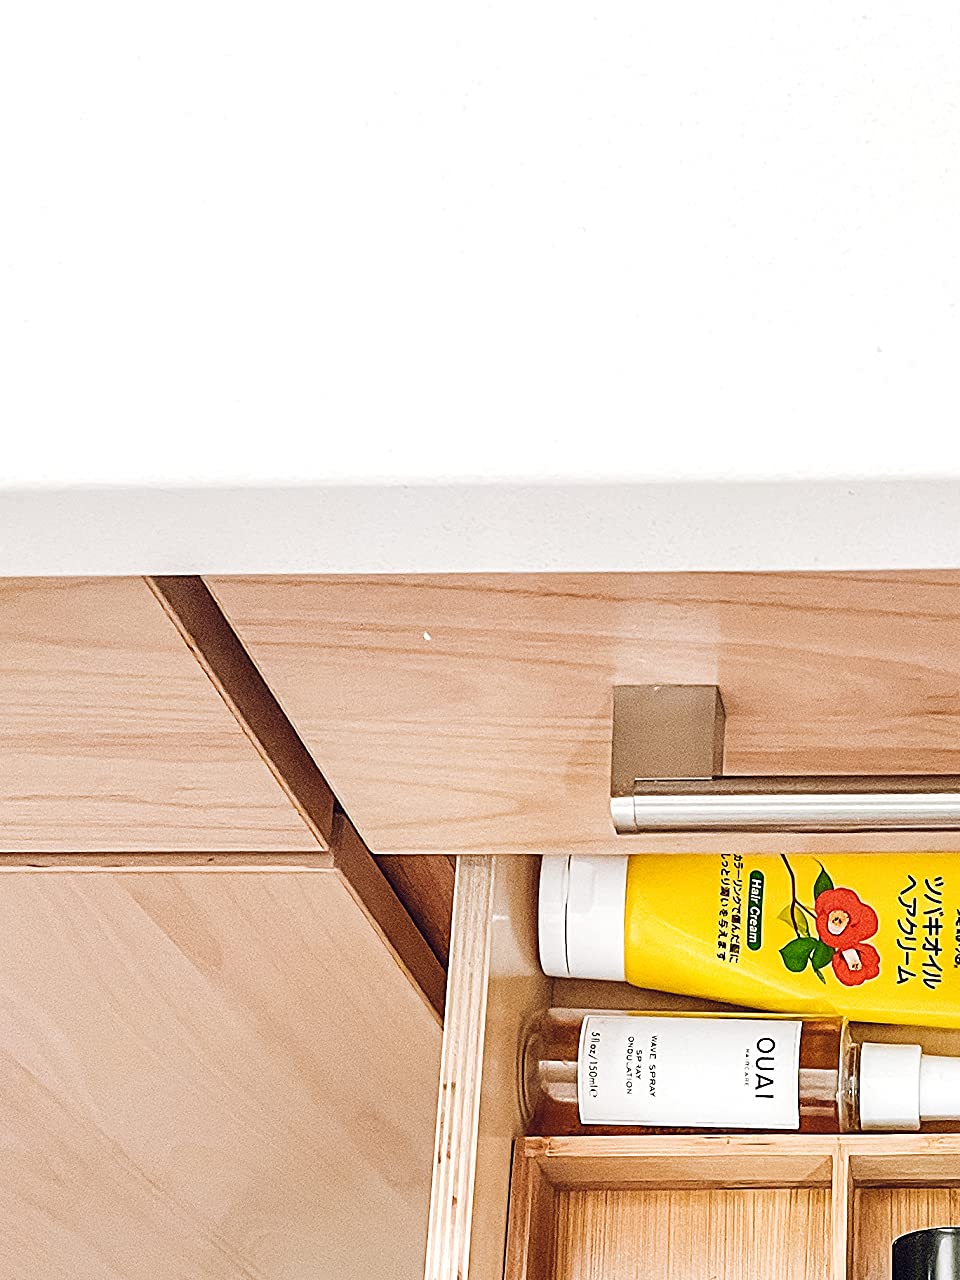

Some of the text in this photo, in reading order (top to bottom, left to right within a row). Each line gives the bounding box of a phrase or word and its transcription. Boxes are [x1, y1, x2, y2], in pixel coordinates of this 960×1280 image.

[748, 878, 762, 943] Hair Cream
[897, 874, 917, 984] ヘアクリーム
[922, 876, 944, 989] ツバキオイル
[626, 1036, 635, 1094] ONDULATION
[635, 1049, 643, 1080] SPRAY
[649, 1035, 657, 1059] WAVE
[755, 1038, 775, 1098] OUAI
